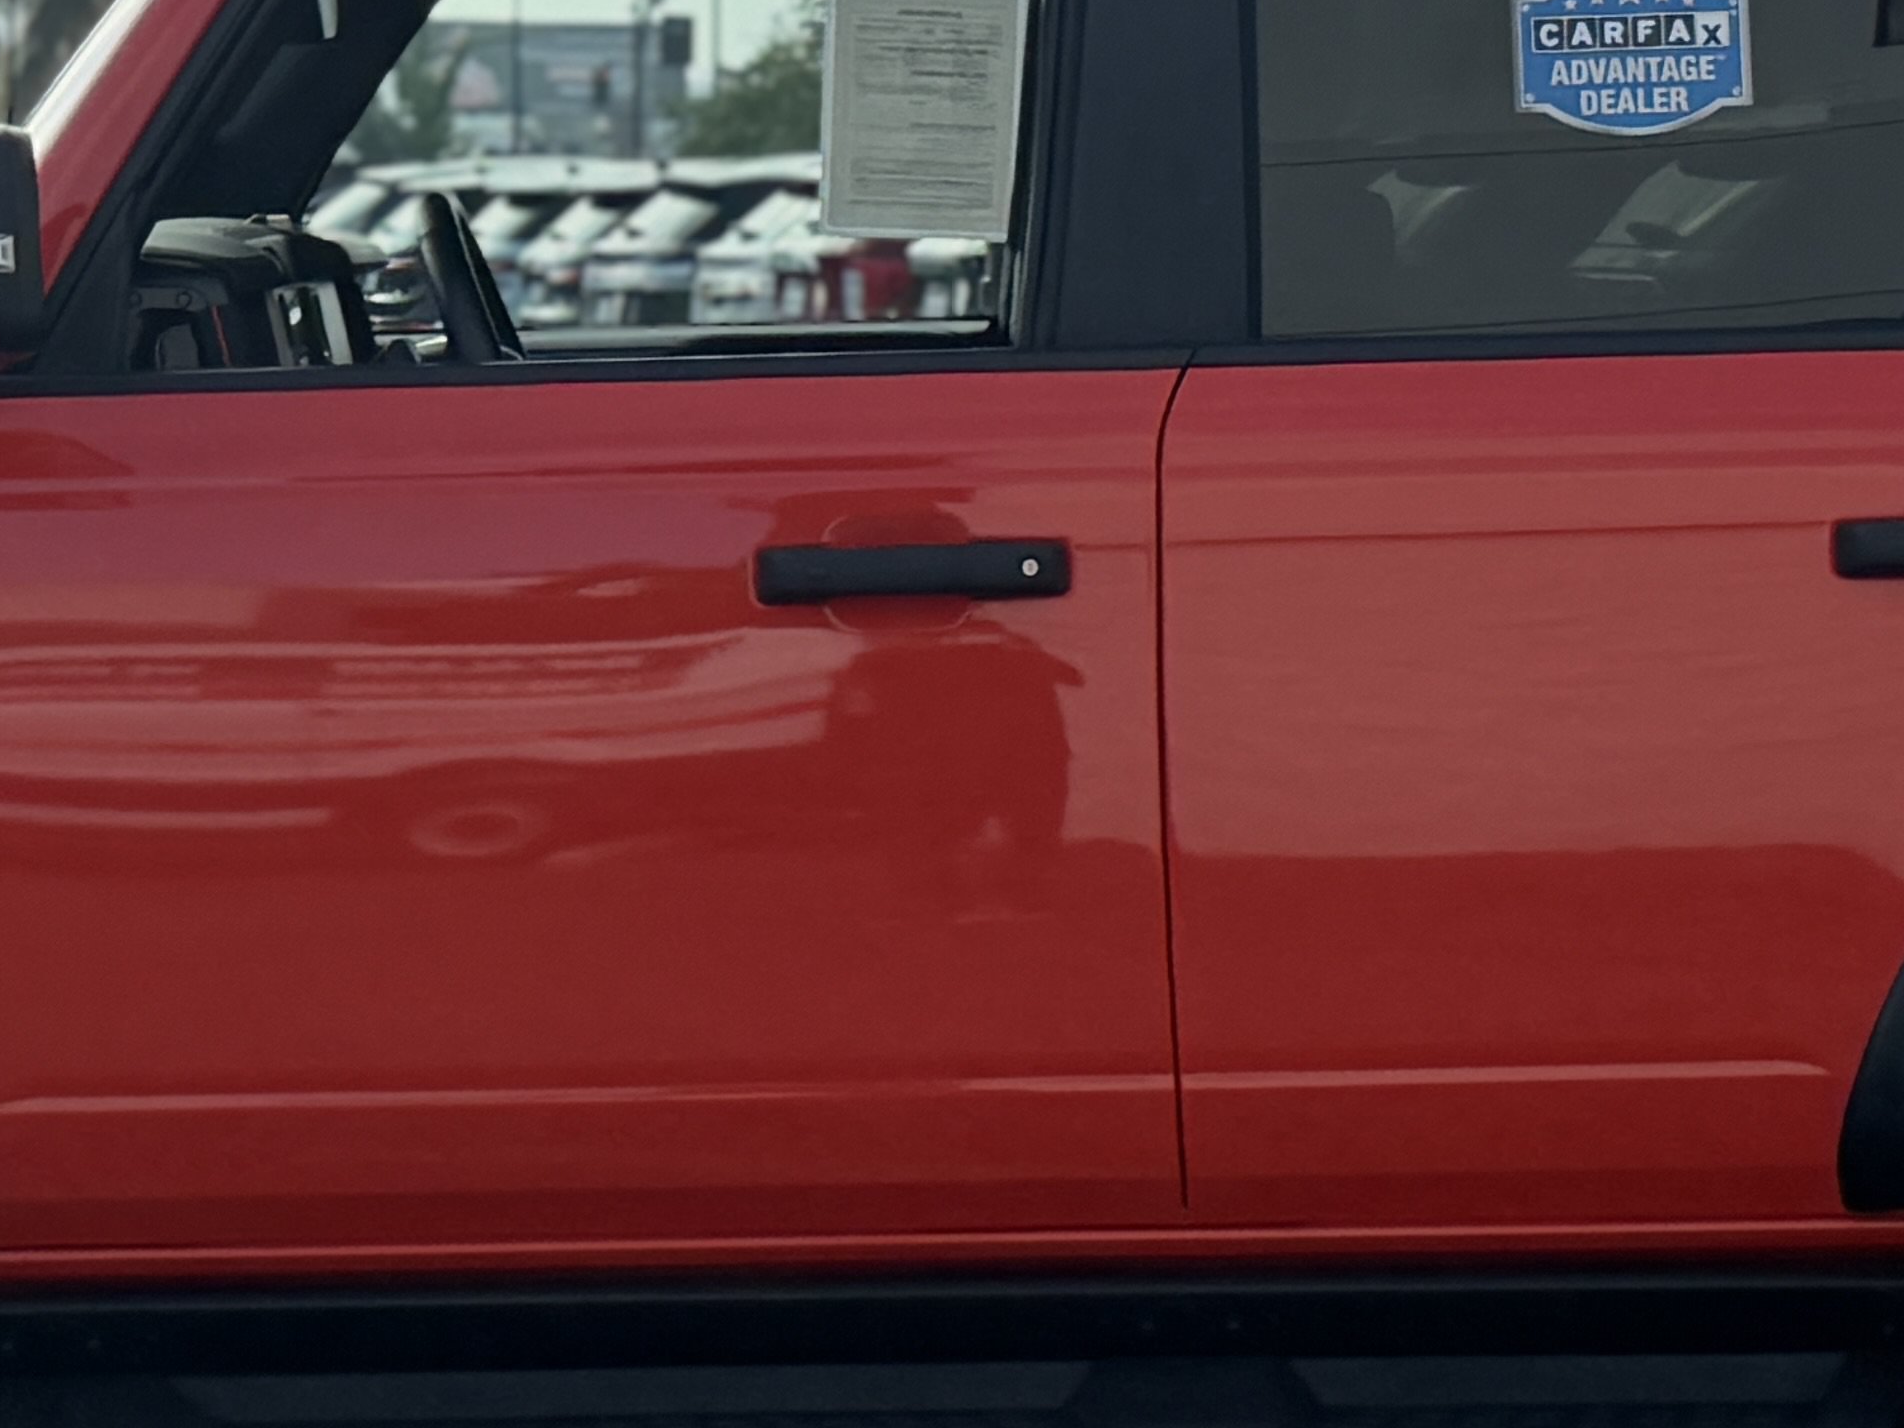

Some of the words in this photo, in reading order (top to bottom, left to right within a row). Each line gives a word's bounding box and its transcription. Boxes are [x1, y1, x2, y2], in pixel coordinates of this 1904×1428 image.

[1538, 17, 1723, 48] CARFAX
[1550, 55, 1717, 86] ADVANTAGE
[1579, 86, 1690, 117] DEALER
